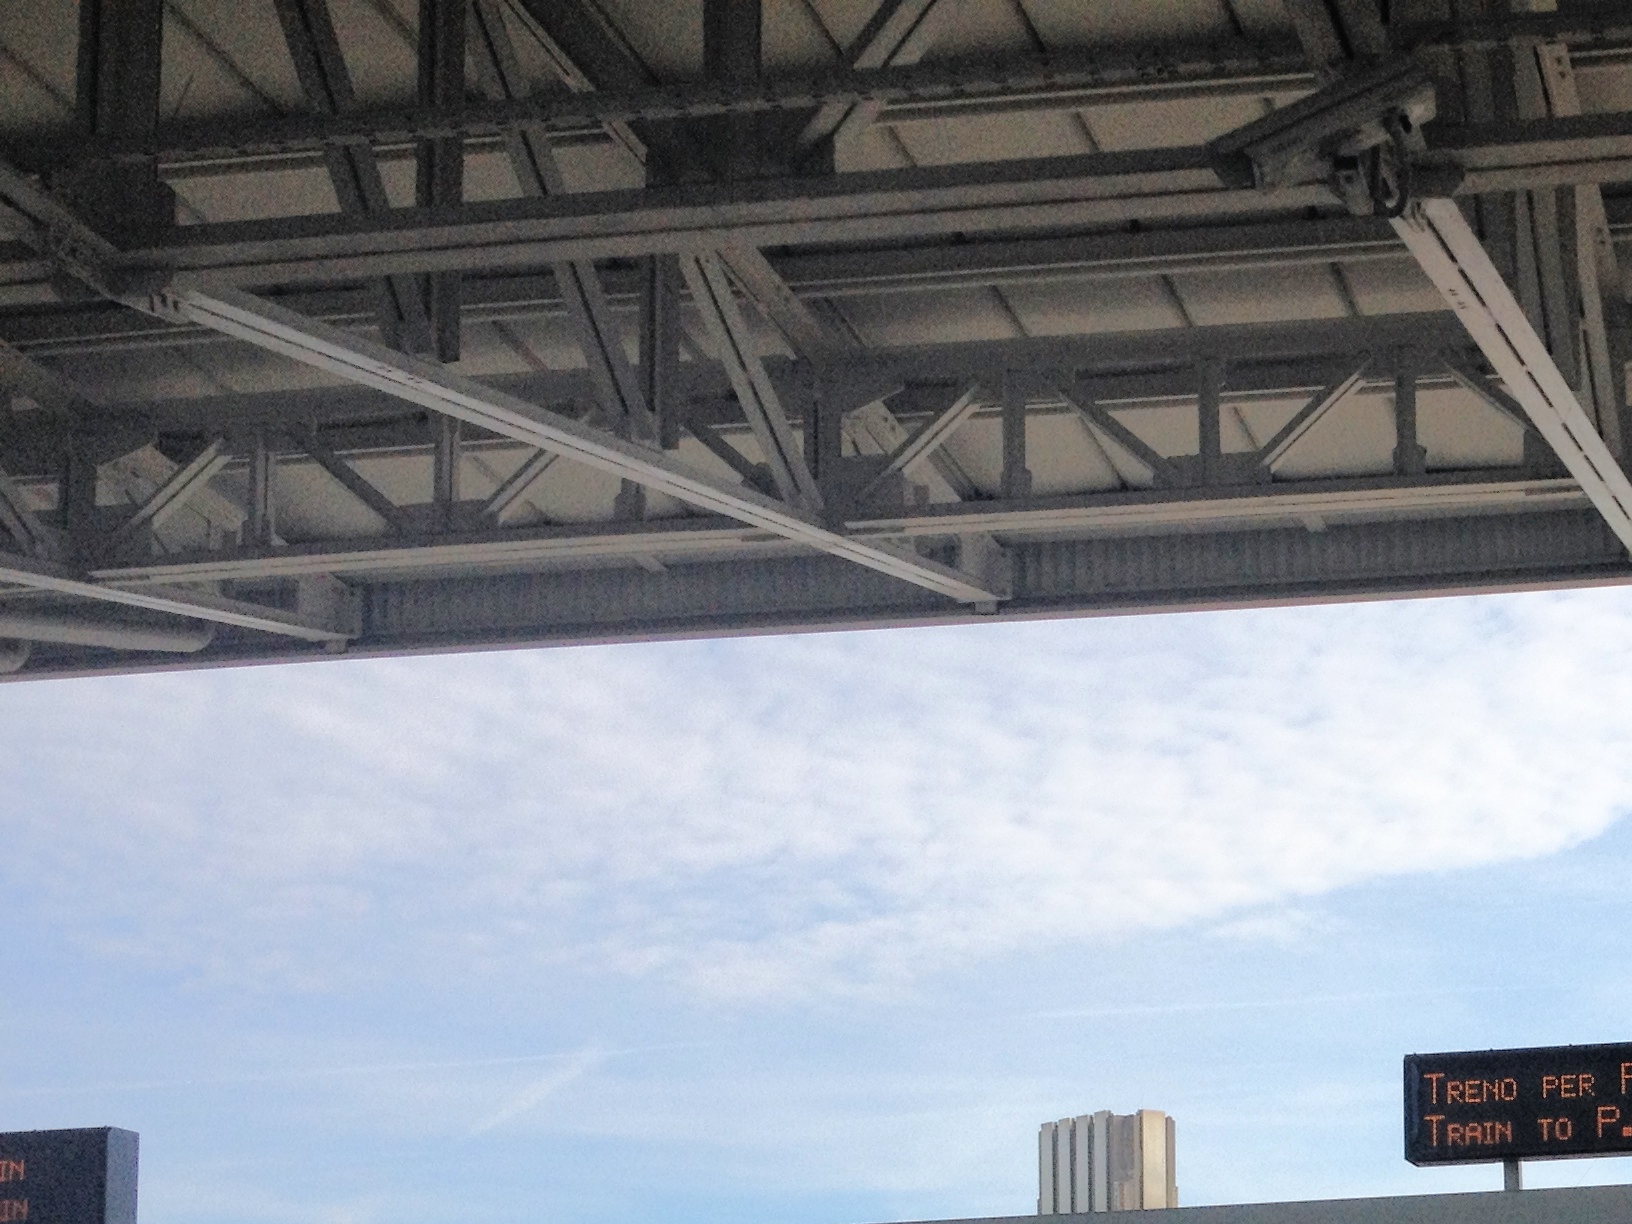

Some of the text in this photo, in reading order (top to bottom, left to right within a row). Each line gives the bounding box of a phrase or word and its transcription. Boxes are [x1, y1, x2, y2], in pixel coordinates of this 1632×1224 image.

[1424, 1073, 1517, 1104] TRENO
[1542, 1074, 1595, 1099] PER
[1424, 1115, 1512, 1147] TRAIN
[1538, 1117, 1573, 1141] TO
